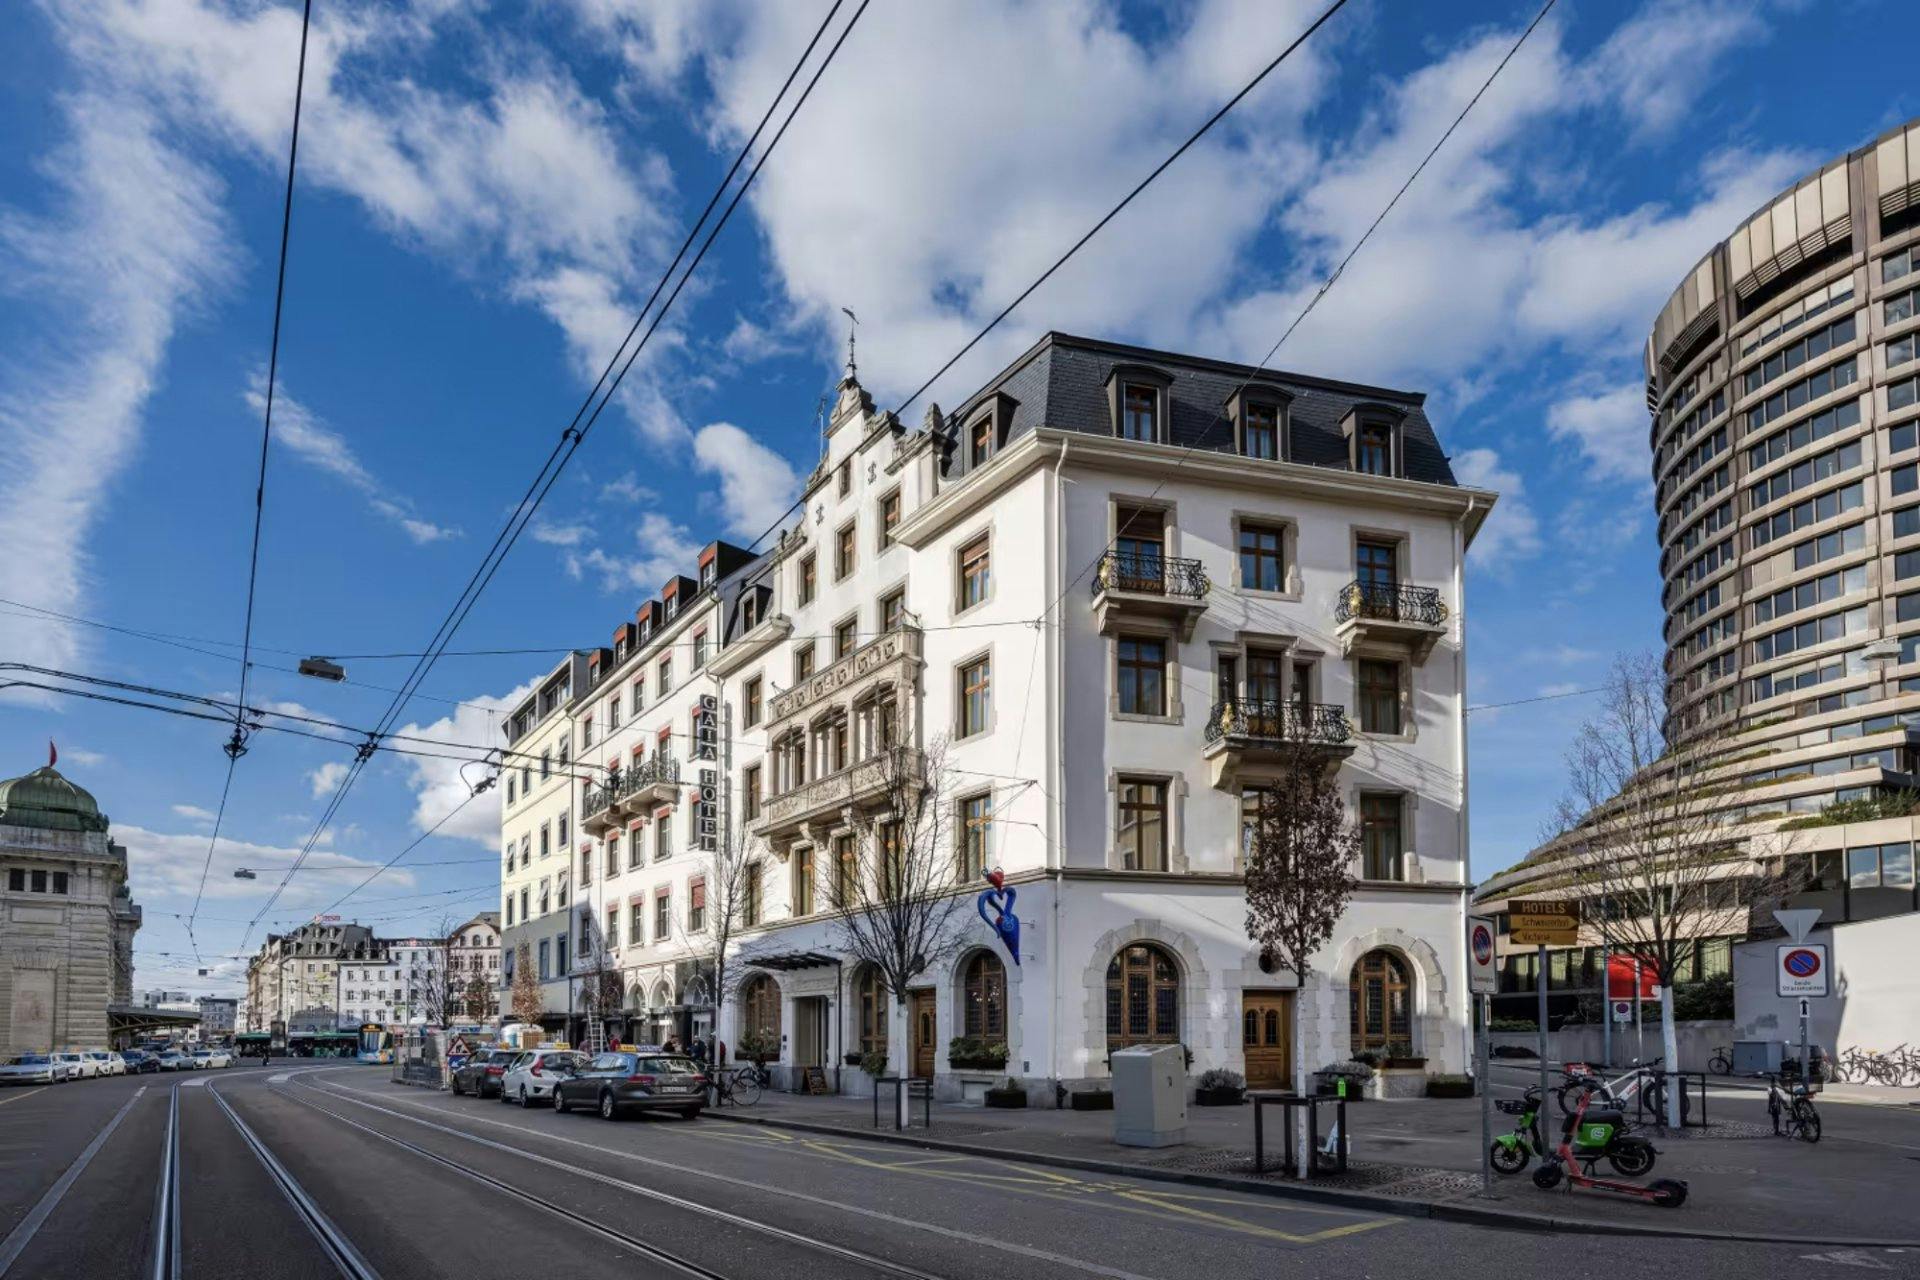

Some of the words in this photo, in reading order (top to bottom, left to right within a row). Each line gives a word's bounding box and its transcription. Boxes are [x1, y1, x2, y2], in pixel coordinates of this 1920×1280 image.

[703, 696, 716, 759] GAIA
[703, 770, 716, 850] HOTEL
[1522, 902, 1566, 914] HOTELS
